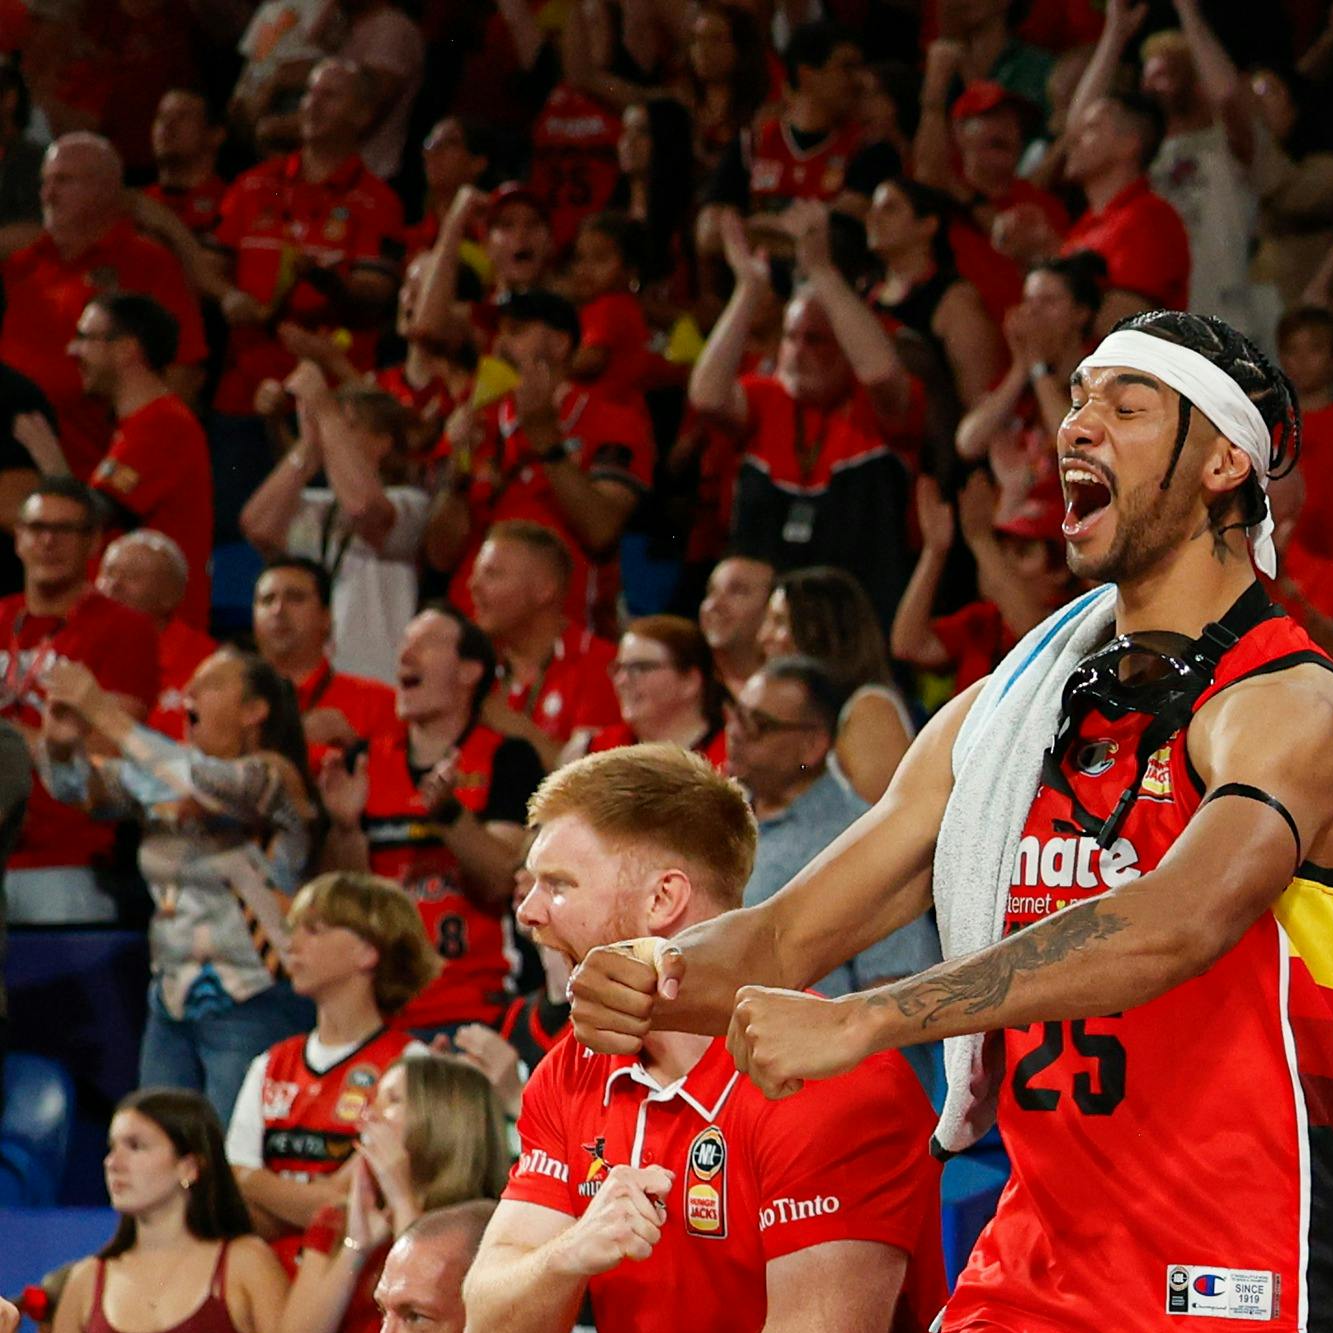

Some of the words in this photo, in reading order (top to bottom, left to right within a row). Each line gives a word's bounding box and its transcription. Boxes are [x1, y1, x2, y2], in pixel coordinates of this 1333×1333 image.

[1013, 1013, 1127, 1116] 25
[1235, 1283, 1264, 1295] SINCE
[1239, 1294, 1260, 1304] 1919
